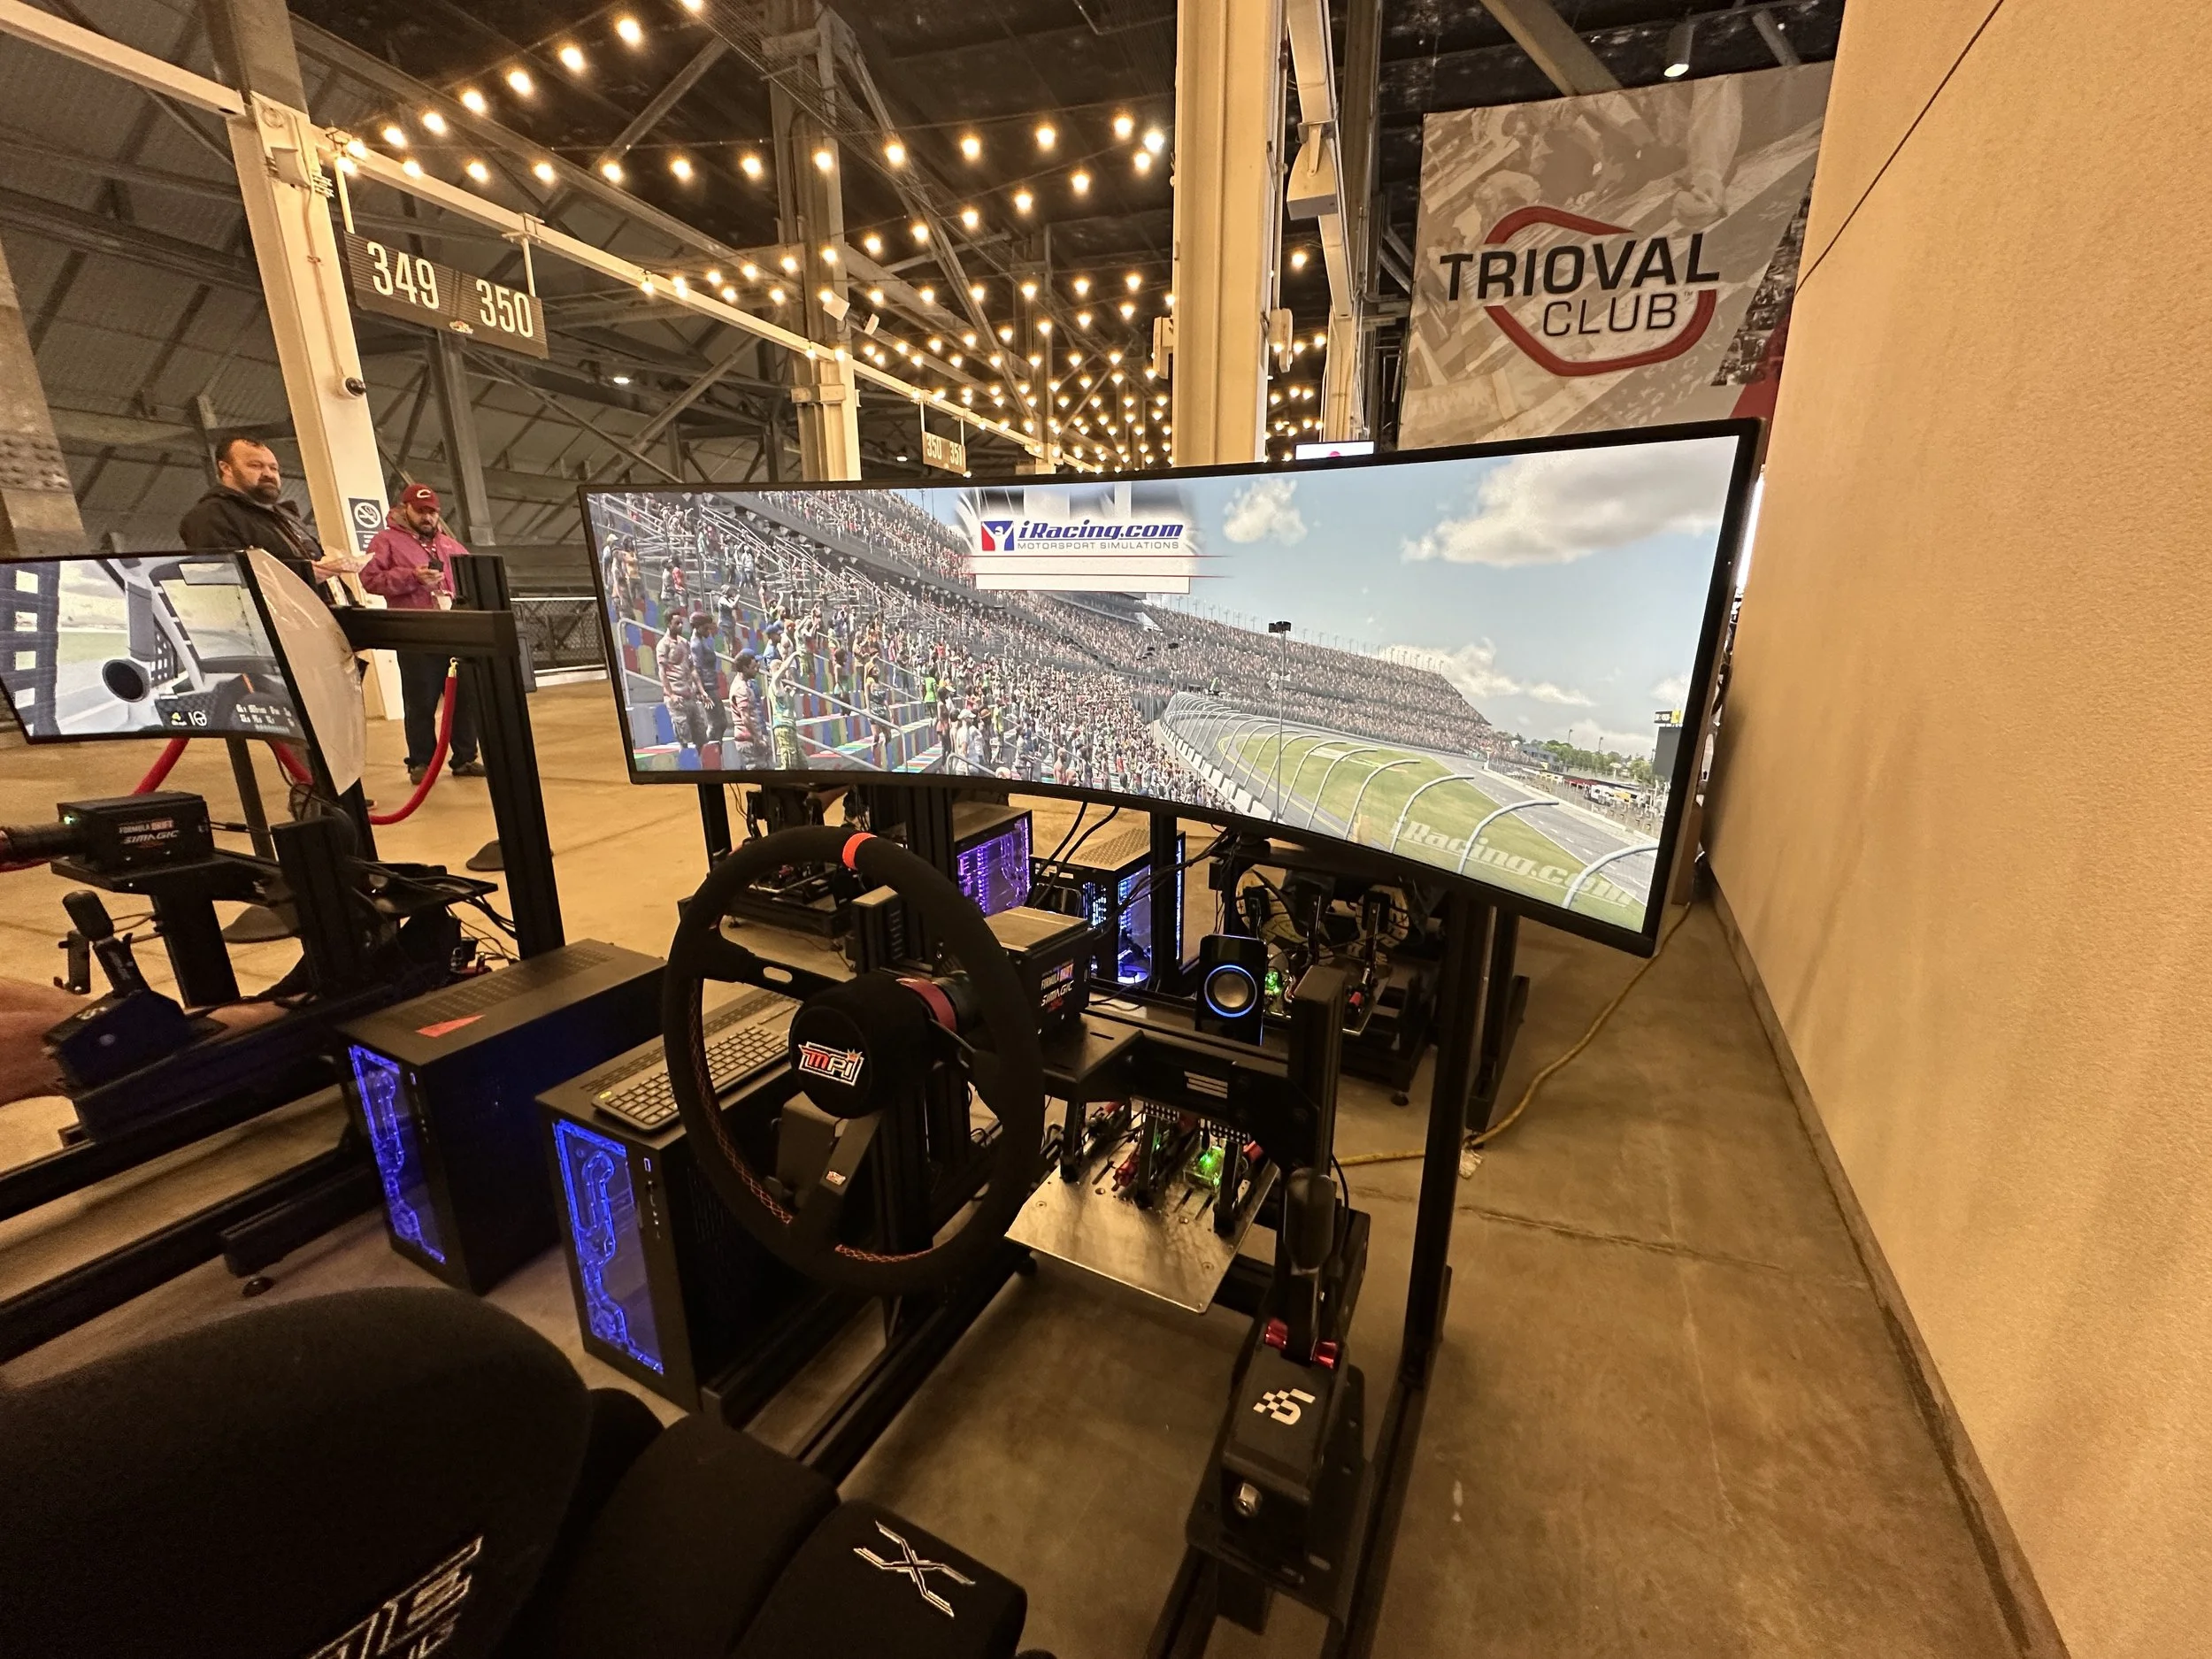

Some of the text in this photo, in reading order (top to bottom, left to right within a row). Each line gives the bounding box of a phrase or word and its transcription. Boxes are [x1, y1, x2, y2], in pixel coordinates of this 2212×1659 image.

[1440, 233, 1720, 302] TRIOVAL
[366, 241, 534, 338] 349 350
[1542, 291, 1678, 337] CLUB
[926, 433, 963, 466] 350 351
[416, 488, 432, 498] C
[1018, 518, 1184, 540] iRacing.com
[1017, 541, 1179, 550] MOTORSPORT SIMULATIONS
[123, 829, 180, 844] SIMAGIC
